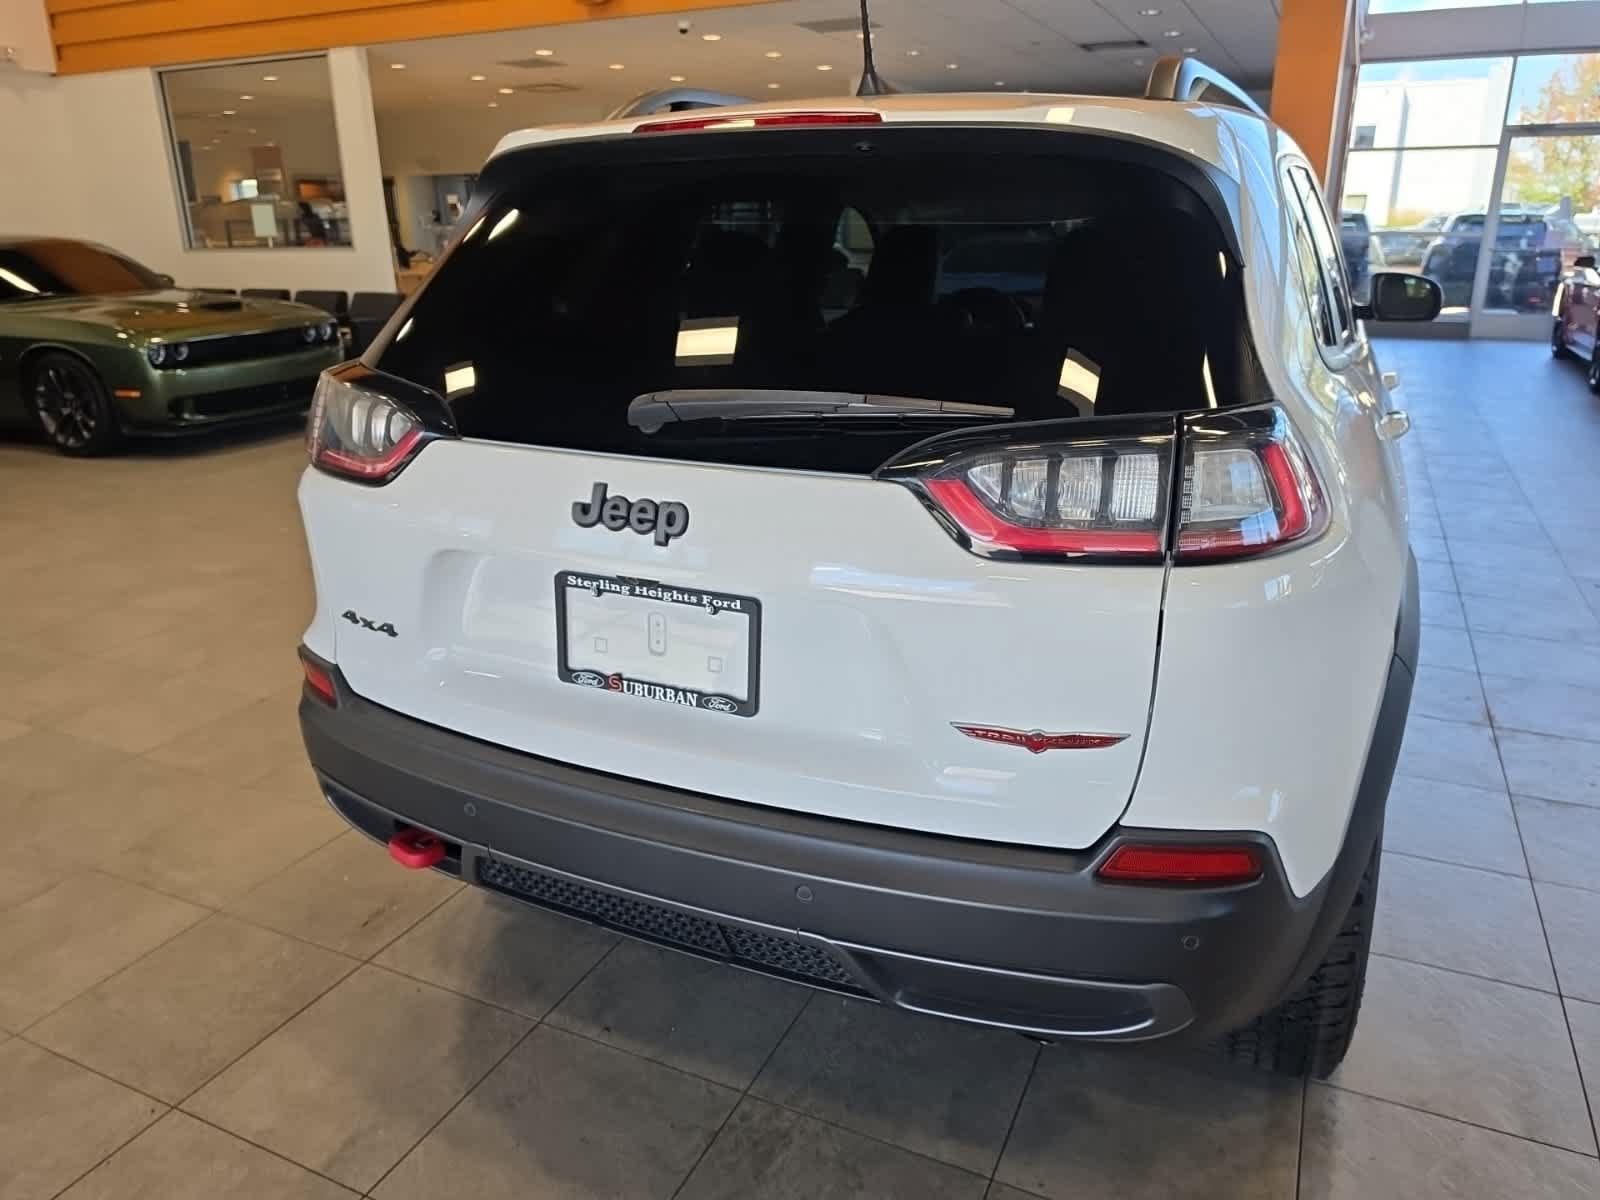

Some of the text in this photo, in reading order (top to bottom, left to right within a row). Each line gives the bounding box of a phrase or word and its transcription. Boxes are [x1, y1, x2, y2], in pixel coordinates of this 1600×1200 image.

[571, 482, 689, 546] Jeep
[567, 575, 741, 610] Sterling Heights Ford
[341, 610, 399, 637] 4x4
[576, 673, 600, 687] Ford
[608, 675, 698, 707] SUBURBAN
[707, 698, 733, 712] Ford
